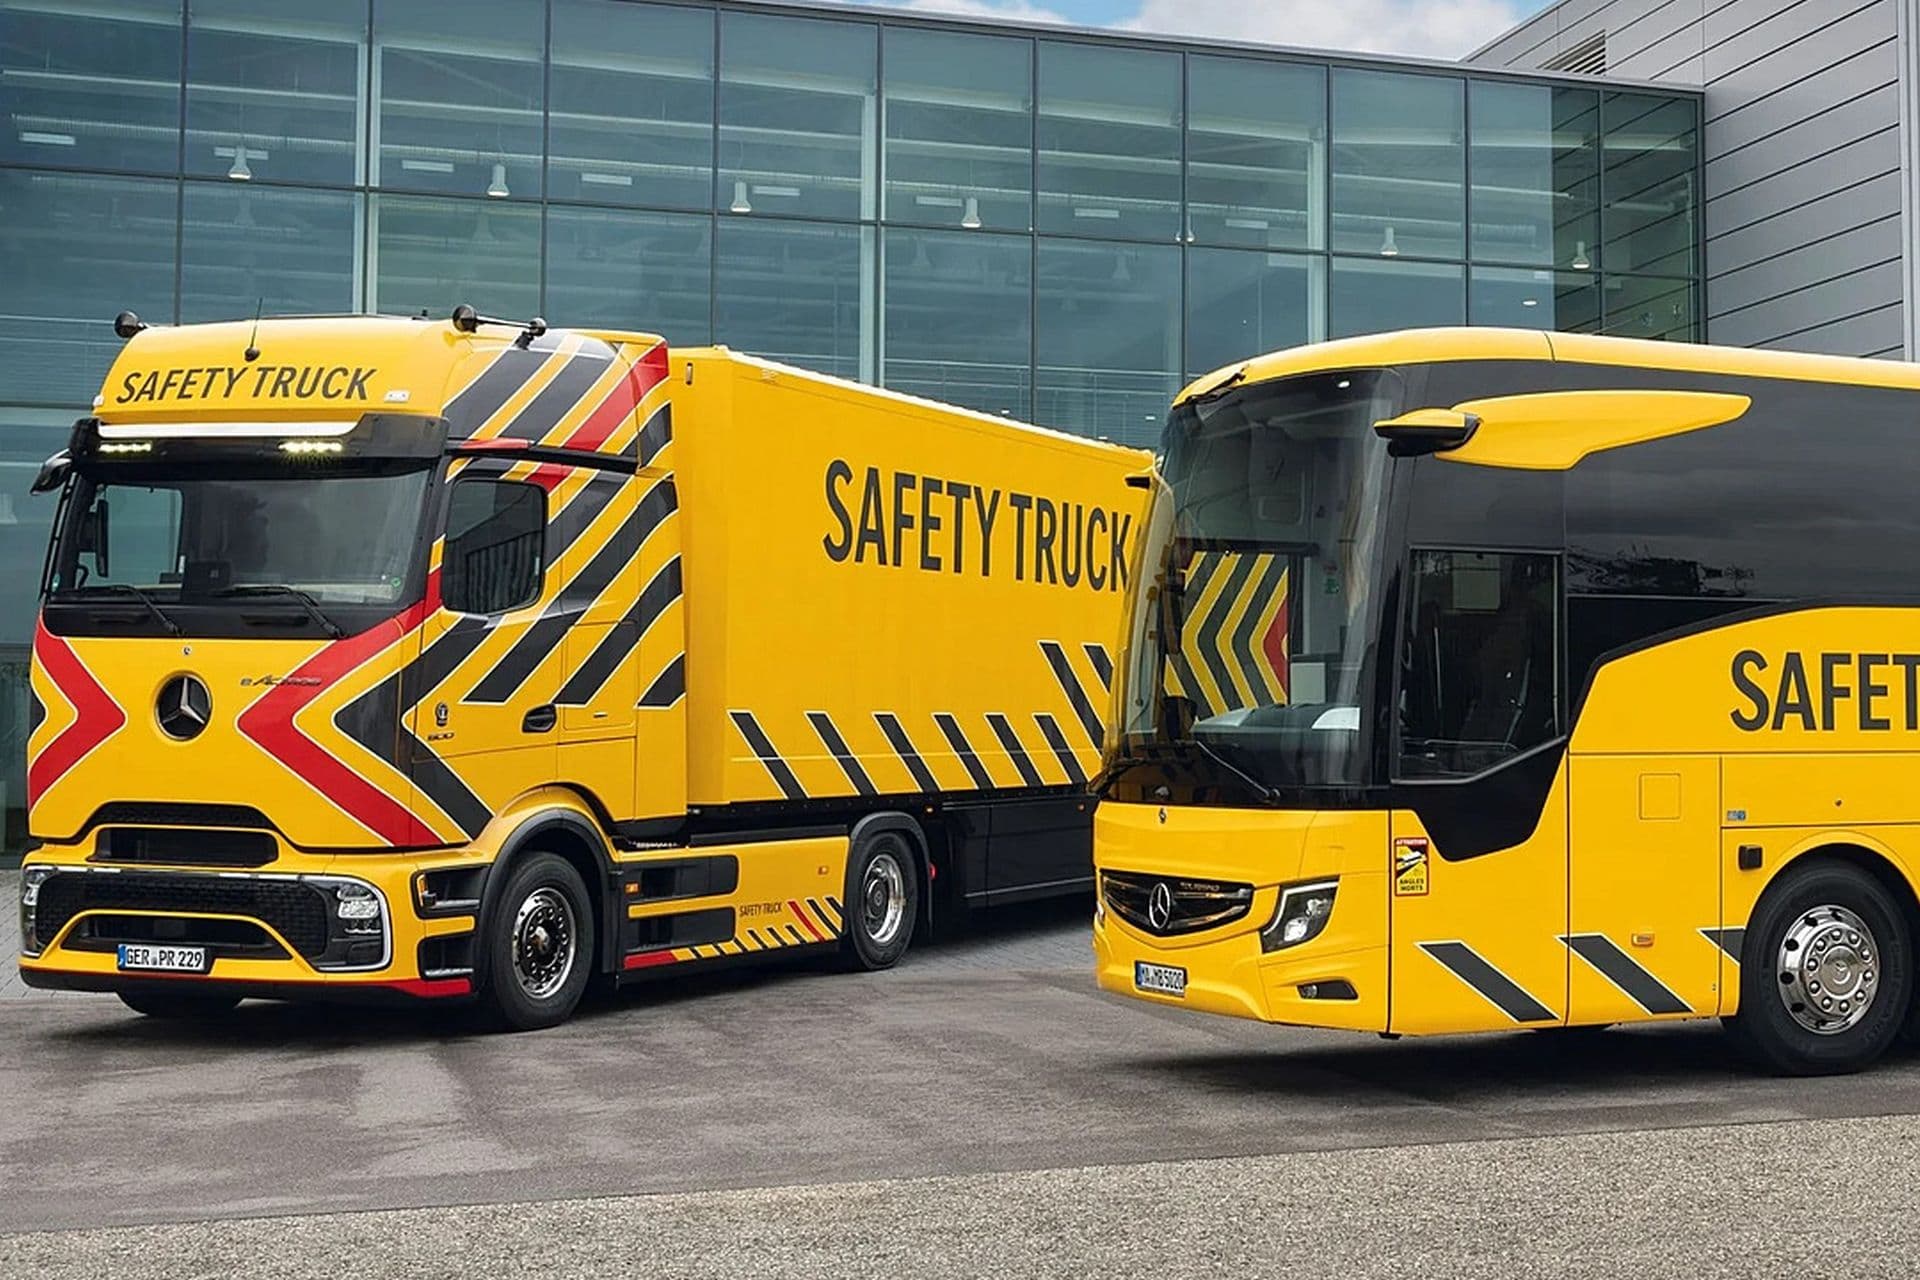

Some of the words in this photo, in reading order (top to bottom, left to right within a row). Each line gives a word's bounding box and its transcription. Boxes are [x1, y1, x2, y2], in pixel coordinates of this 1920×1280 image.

[116, 367, 249, 404] SAFETY
[251, 366, 377, 400] TRUCK
[823, 459, 1001, 577] SAFETY
[1009, 492, 1132, 593] TRUCK
[1730, 650, 1920, 731] SAFET
[740, 903, 761, 917] SAFETY
[762, 901, 782, 914] TRUCK
[126, 948, 150, 966] GER
[159, 950, 175, 967] PR
[178, 951, 203, 968] 229
